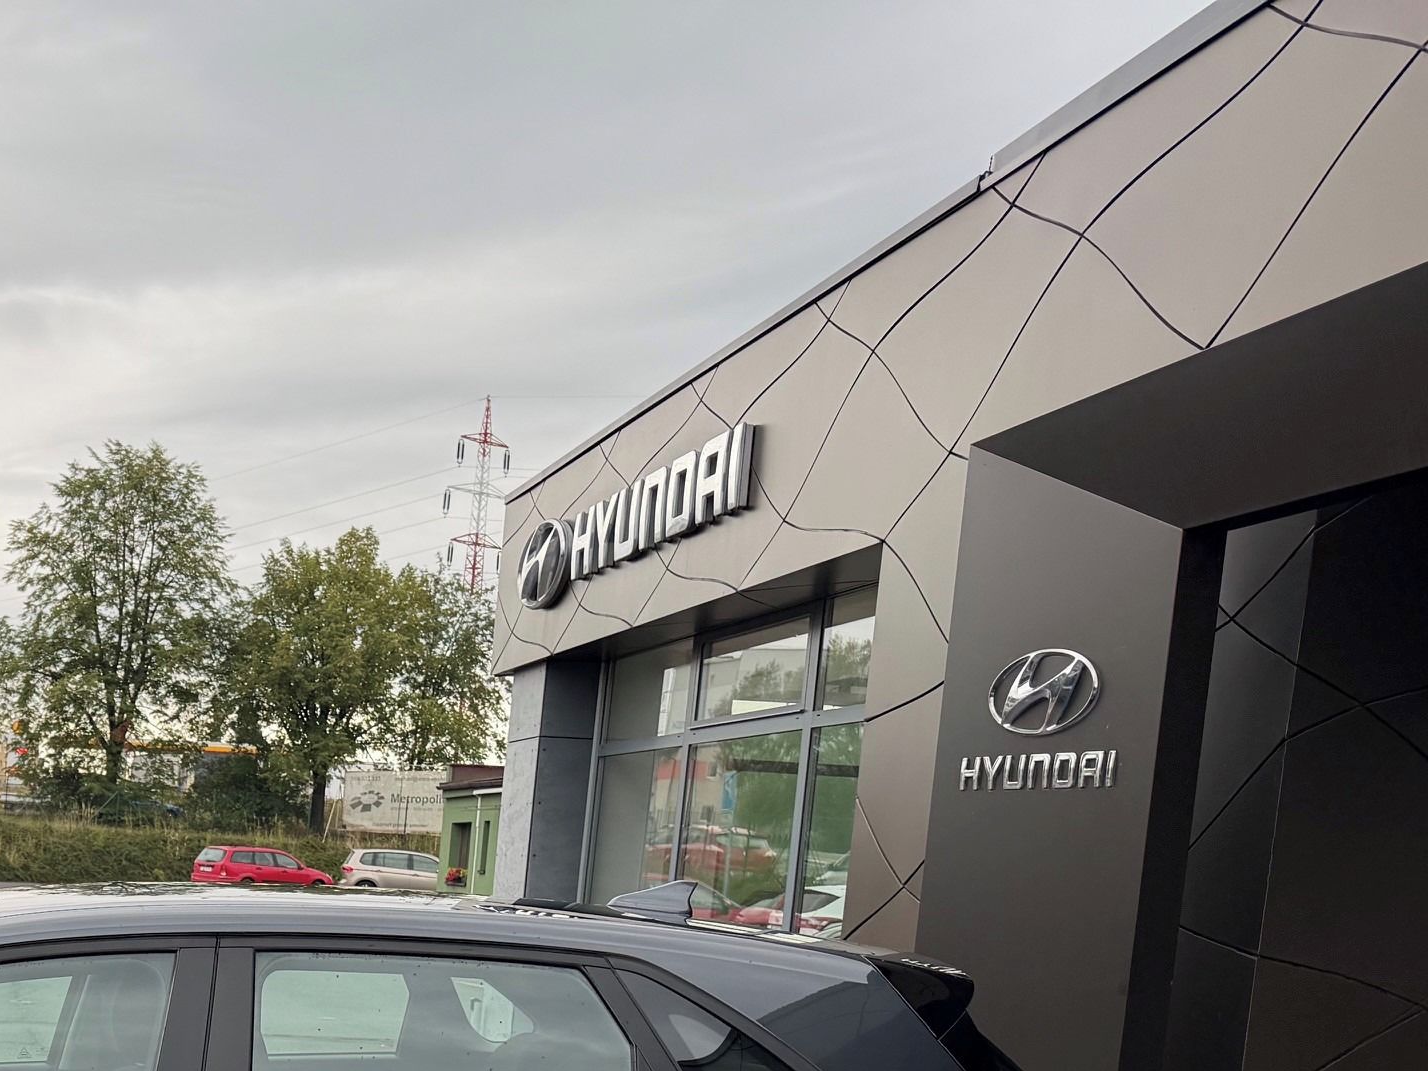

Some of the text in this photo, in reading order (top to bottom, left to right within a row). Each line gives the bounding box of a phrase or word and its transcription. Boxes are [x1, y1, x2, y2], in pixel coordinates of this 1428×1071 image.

[571, 422, 756, 580] HYUNDAI
[959, 750, 1117, 791] HYUNDAI
[390, 793, 445, 806] Metropoli
